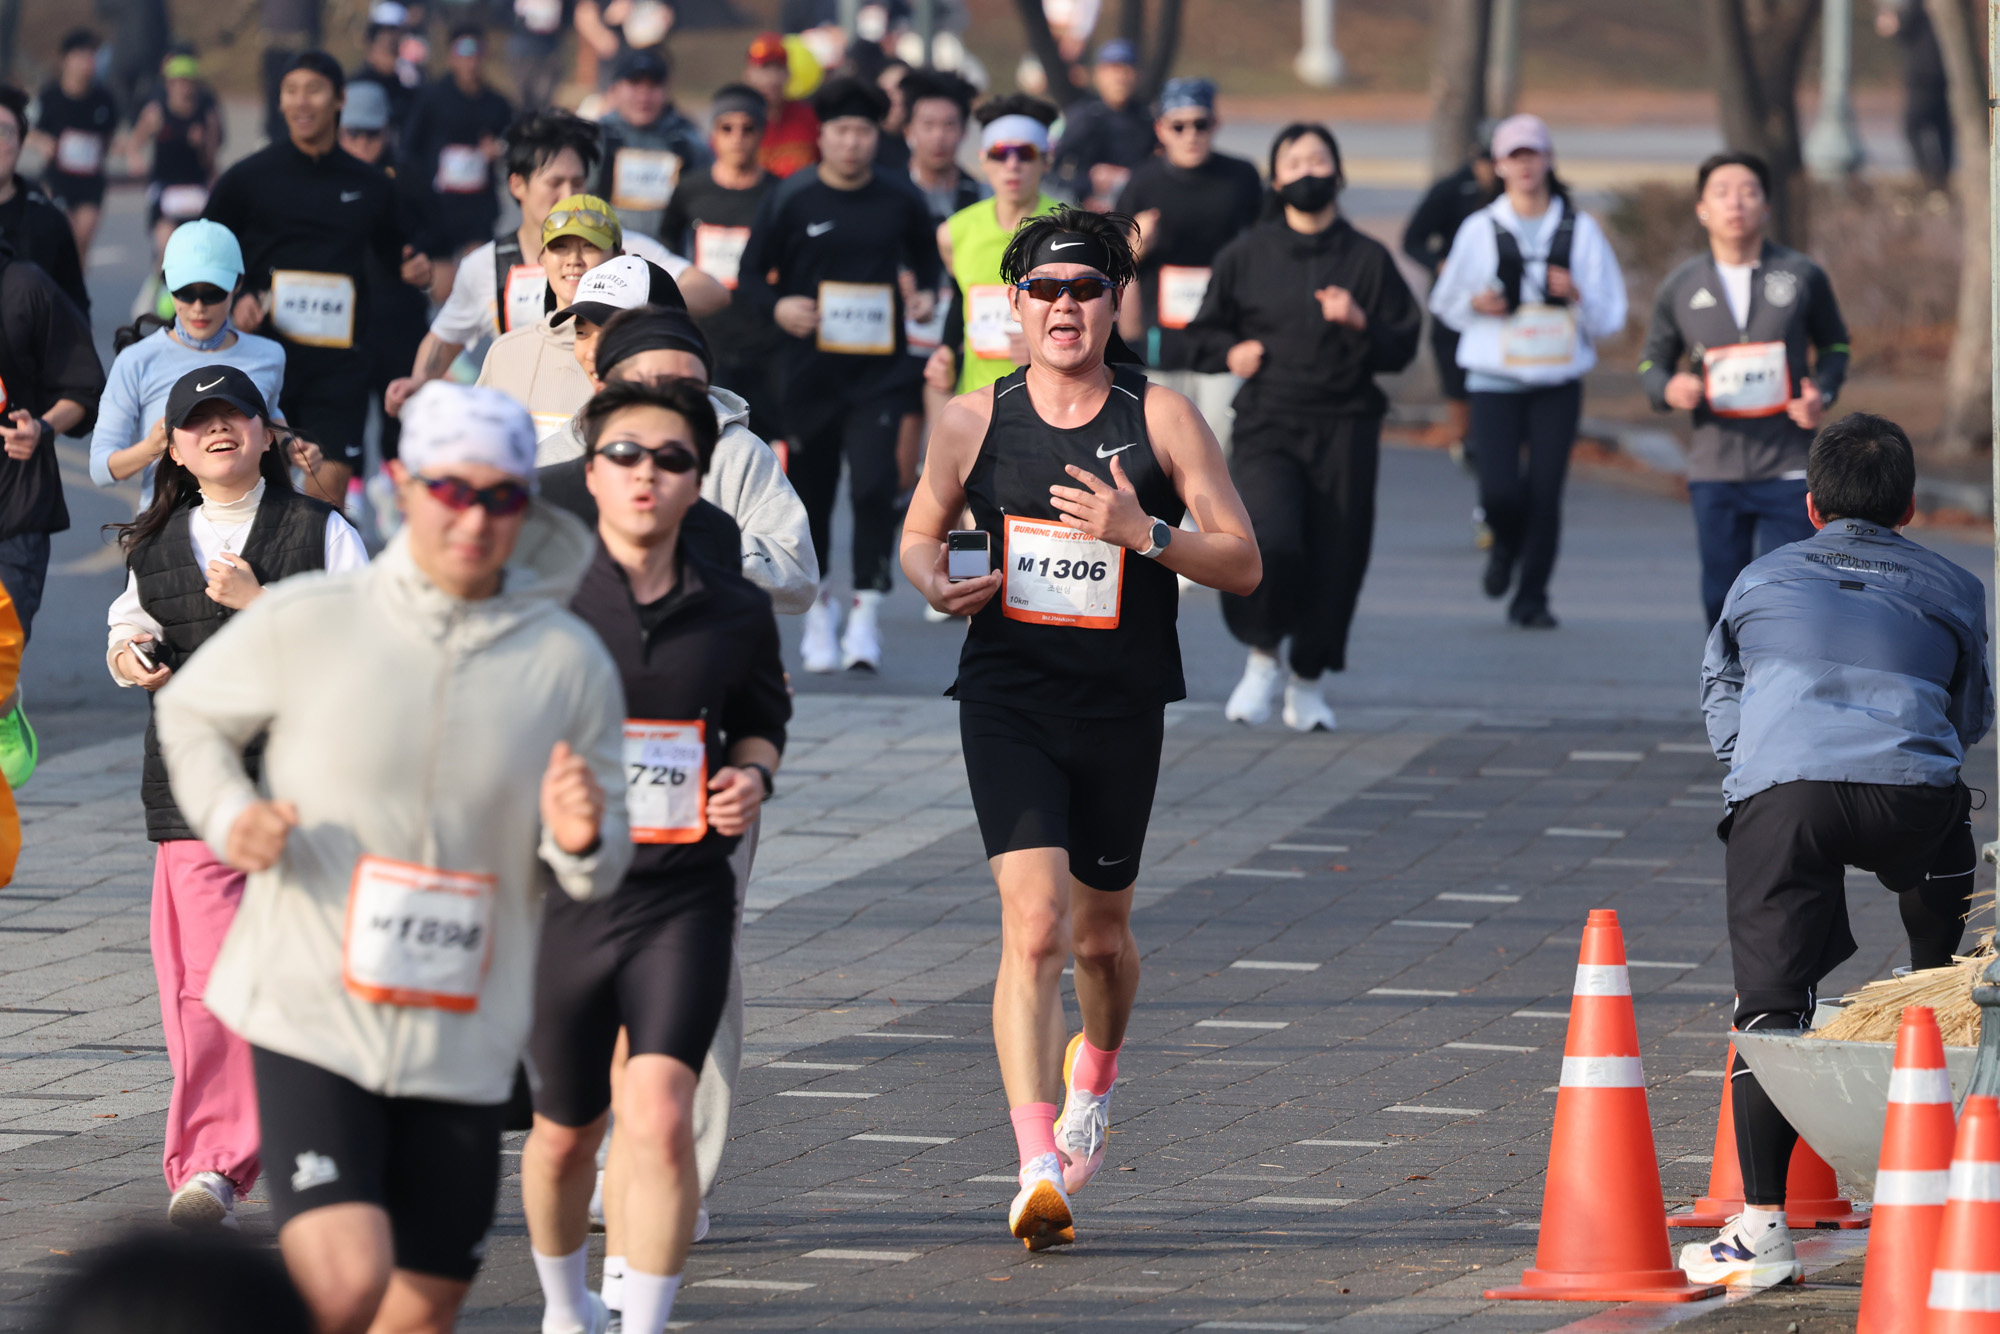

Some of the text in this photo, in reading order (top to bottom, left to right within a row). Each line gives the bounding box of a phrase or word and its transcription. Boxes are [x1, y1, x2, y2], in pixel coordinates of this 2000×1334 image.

[1013, 525, 1099, 541] BURNING RUN STOR
[1017, 556, 1107, 582] M1306
[1010, 595, 1029, 606] 10km
